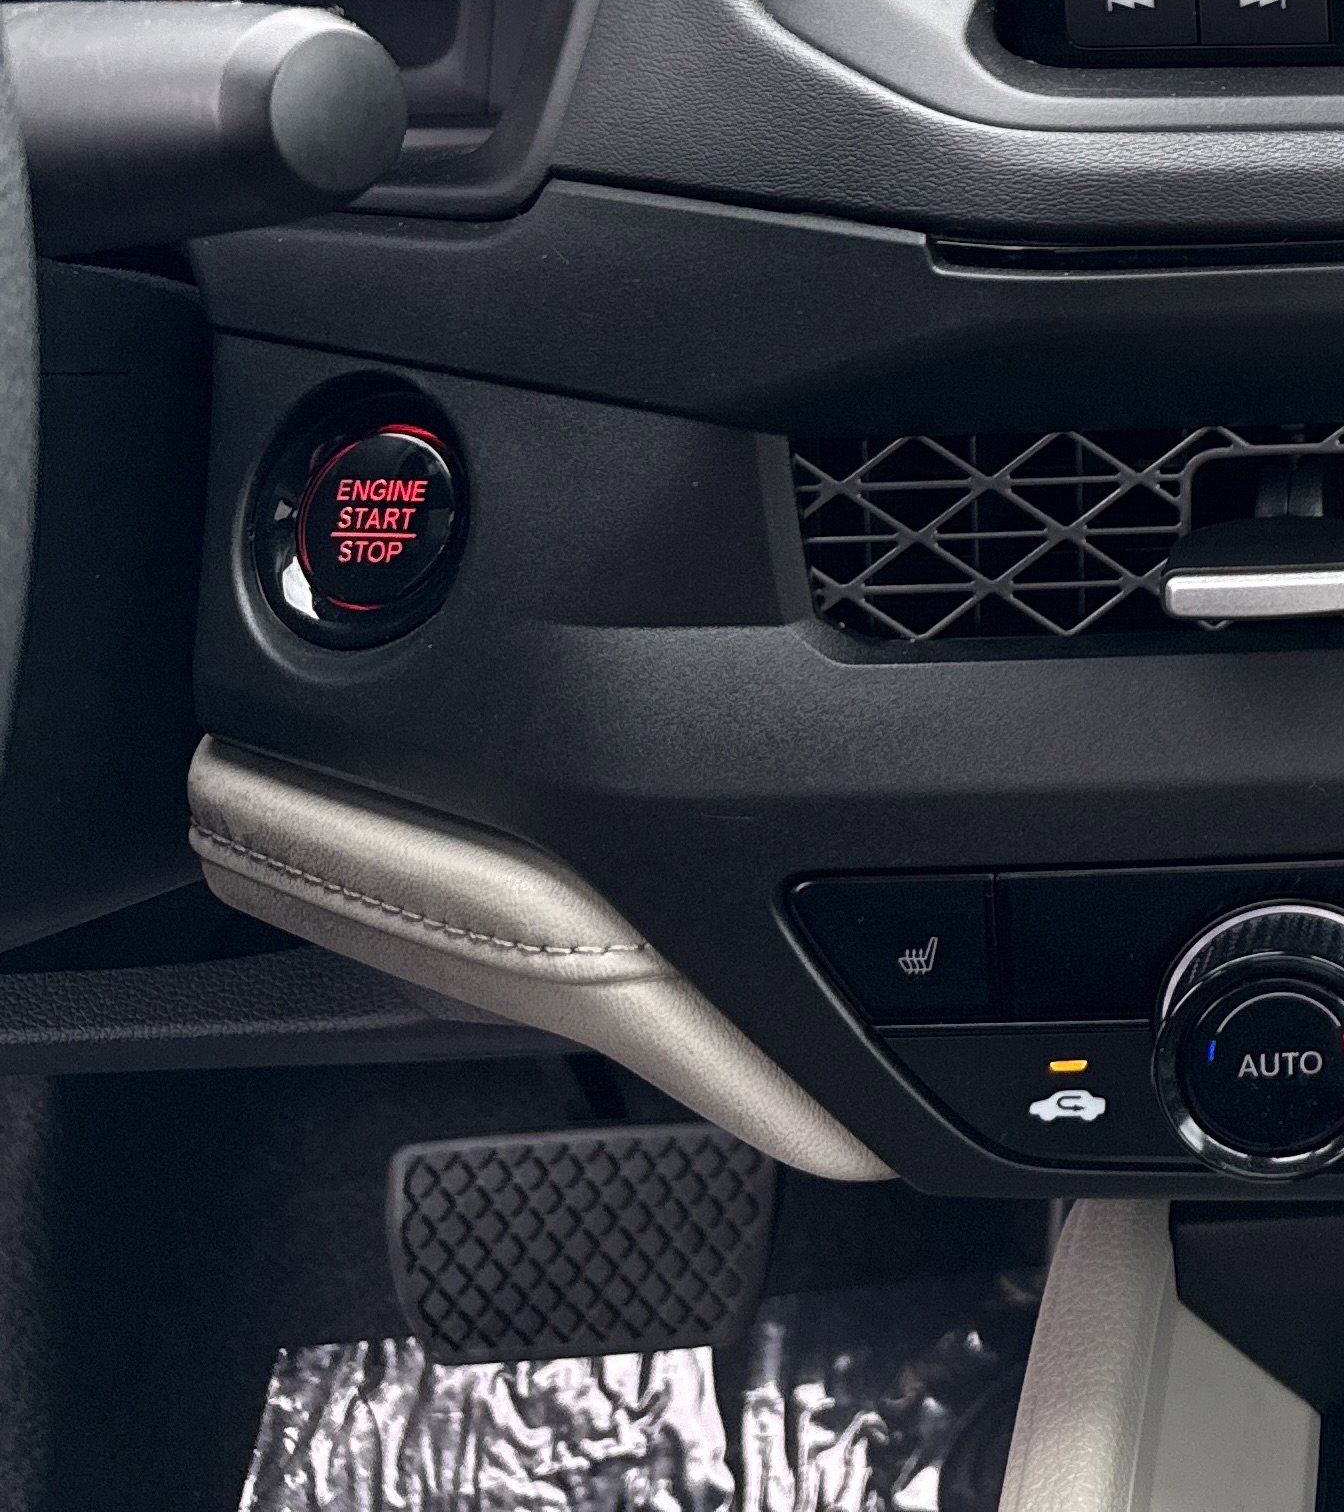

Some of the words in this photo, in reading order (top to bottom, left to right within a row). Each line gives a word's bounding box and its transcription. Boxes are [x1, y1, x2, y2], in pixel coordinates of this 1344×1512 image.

[337, 479, 428, 501] ENGINE
[338, 507, 415, 529] START
[338, 541, 402, 563] STOP
[1237, 1050, 1324, 1078] AUTO
